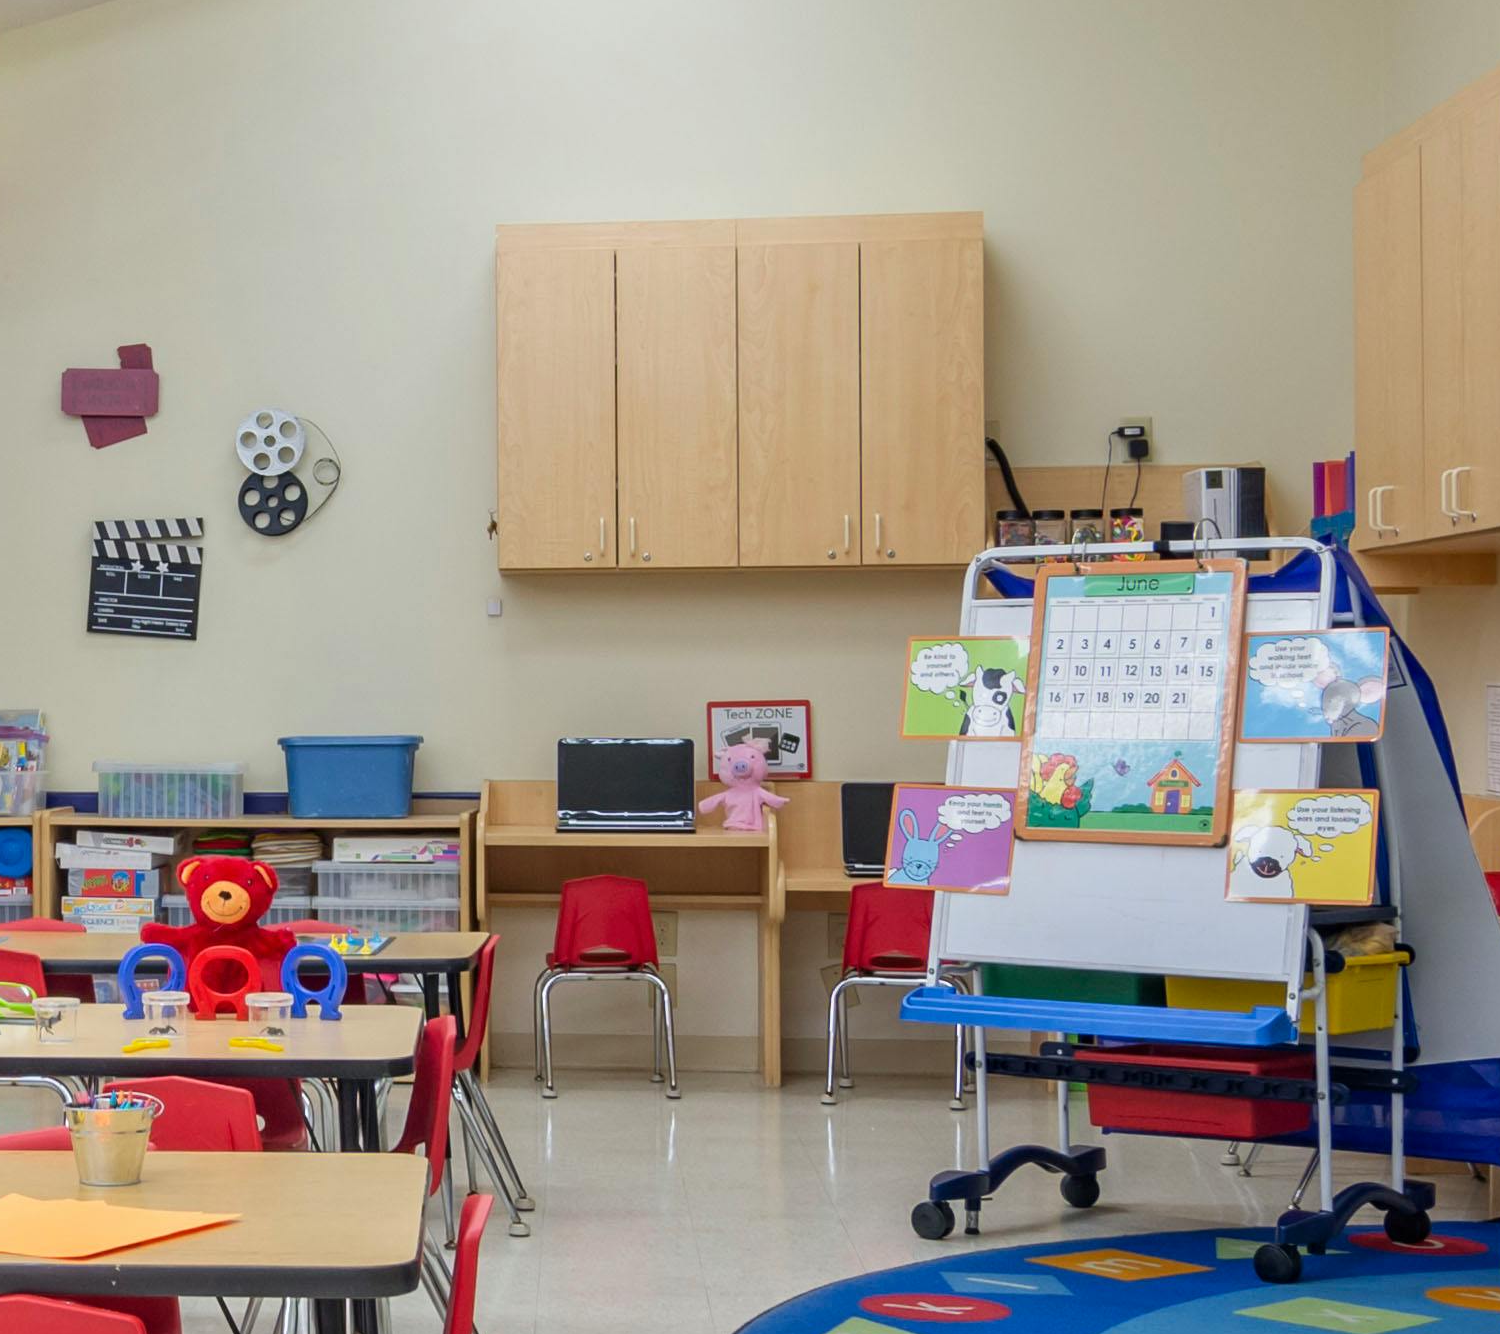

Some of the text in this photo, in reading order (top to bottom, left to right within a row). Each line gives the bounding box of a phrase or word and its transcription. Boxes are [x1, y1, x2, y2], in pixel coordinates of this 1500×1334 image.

[1117, 577, 1160, 592] June
[1211, 606, 1216, 617] 1
[1056, 636, 1213, 650] 2 3 4 5 6 7 8
[1052, 664, 1214, 677] 9 10 11 12 13 14 15
[1050, 692, 1186, 704] 16 17 18 19 20 21
[724, 708, 793, 719] Tech ZONE
[882, 1302, 974, 1315] k
